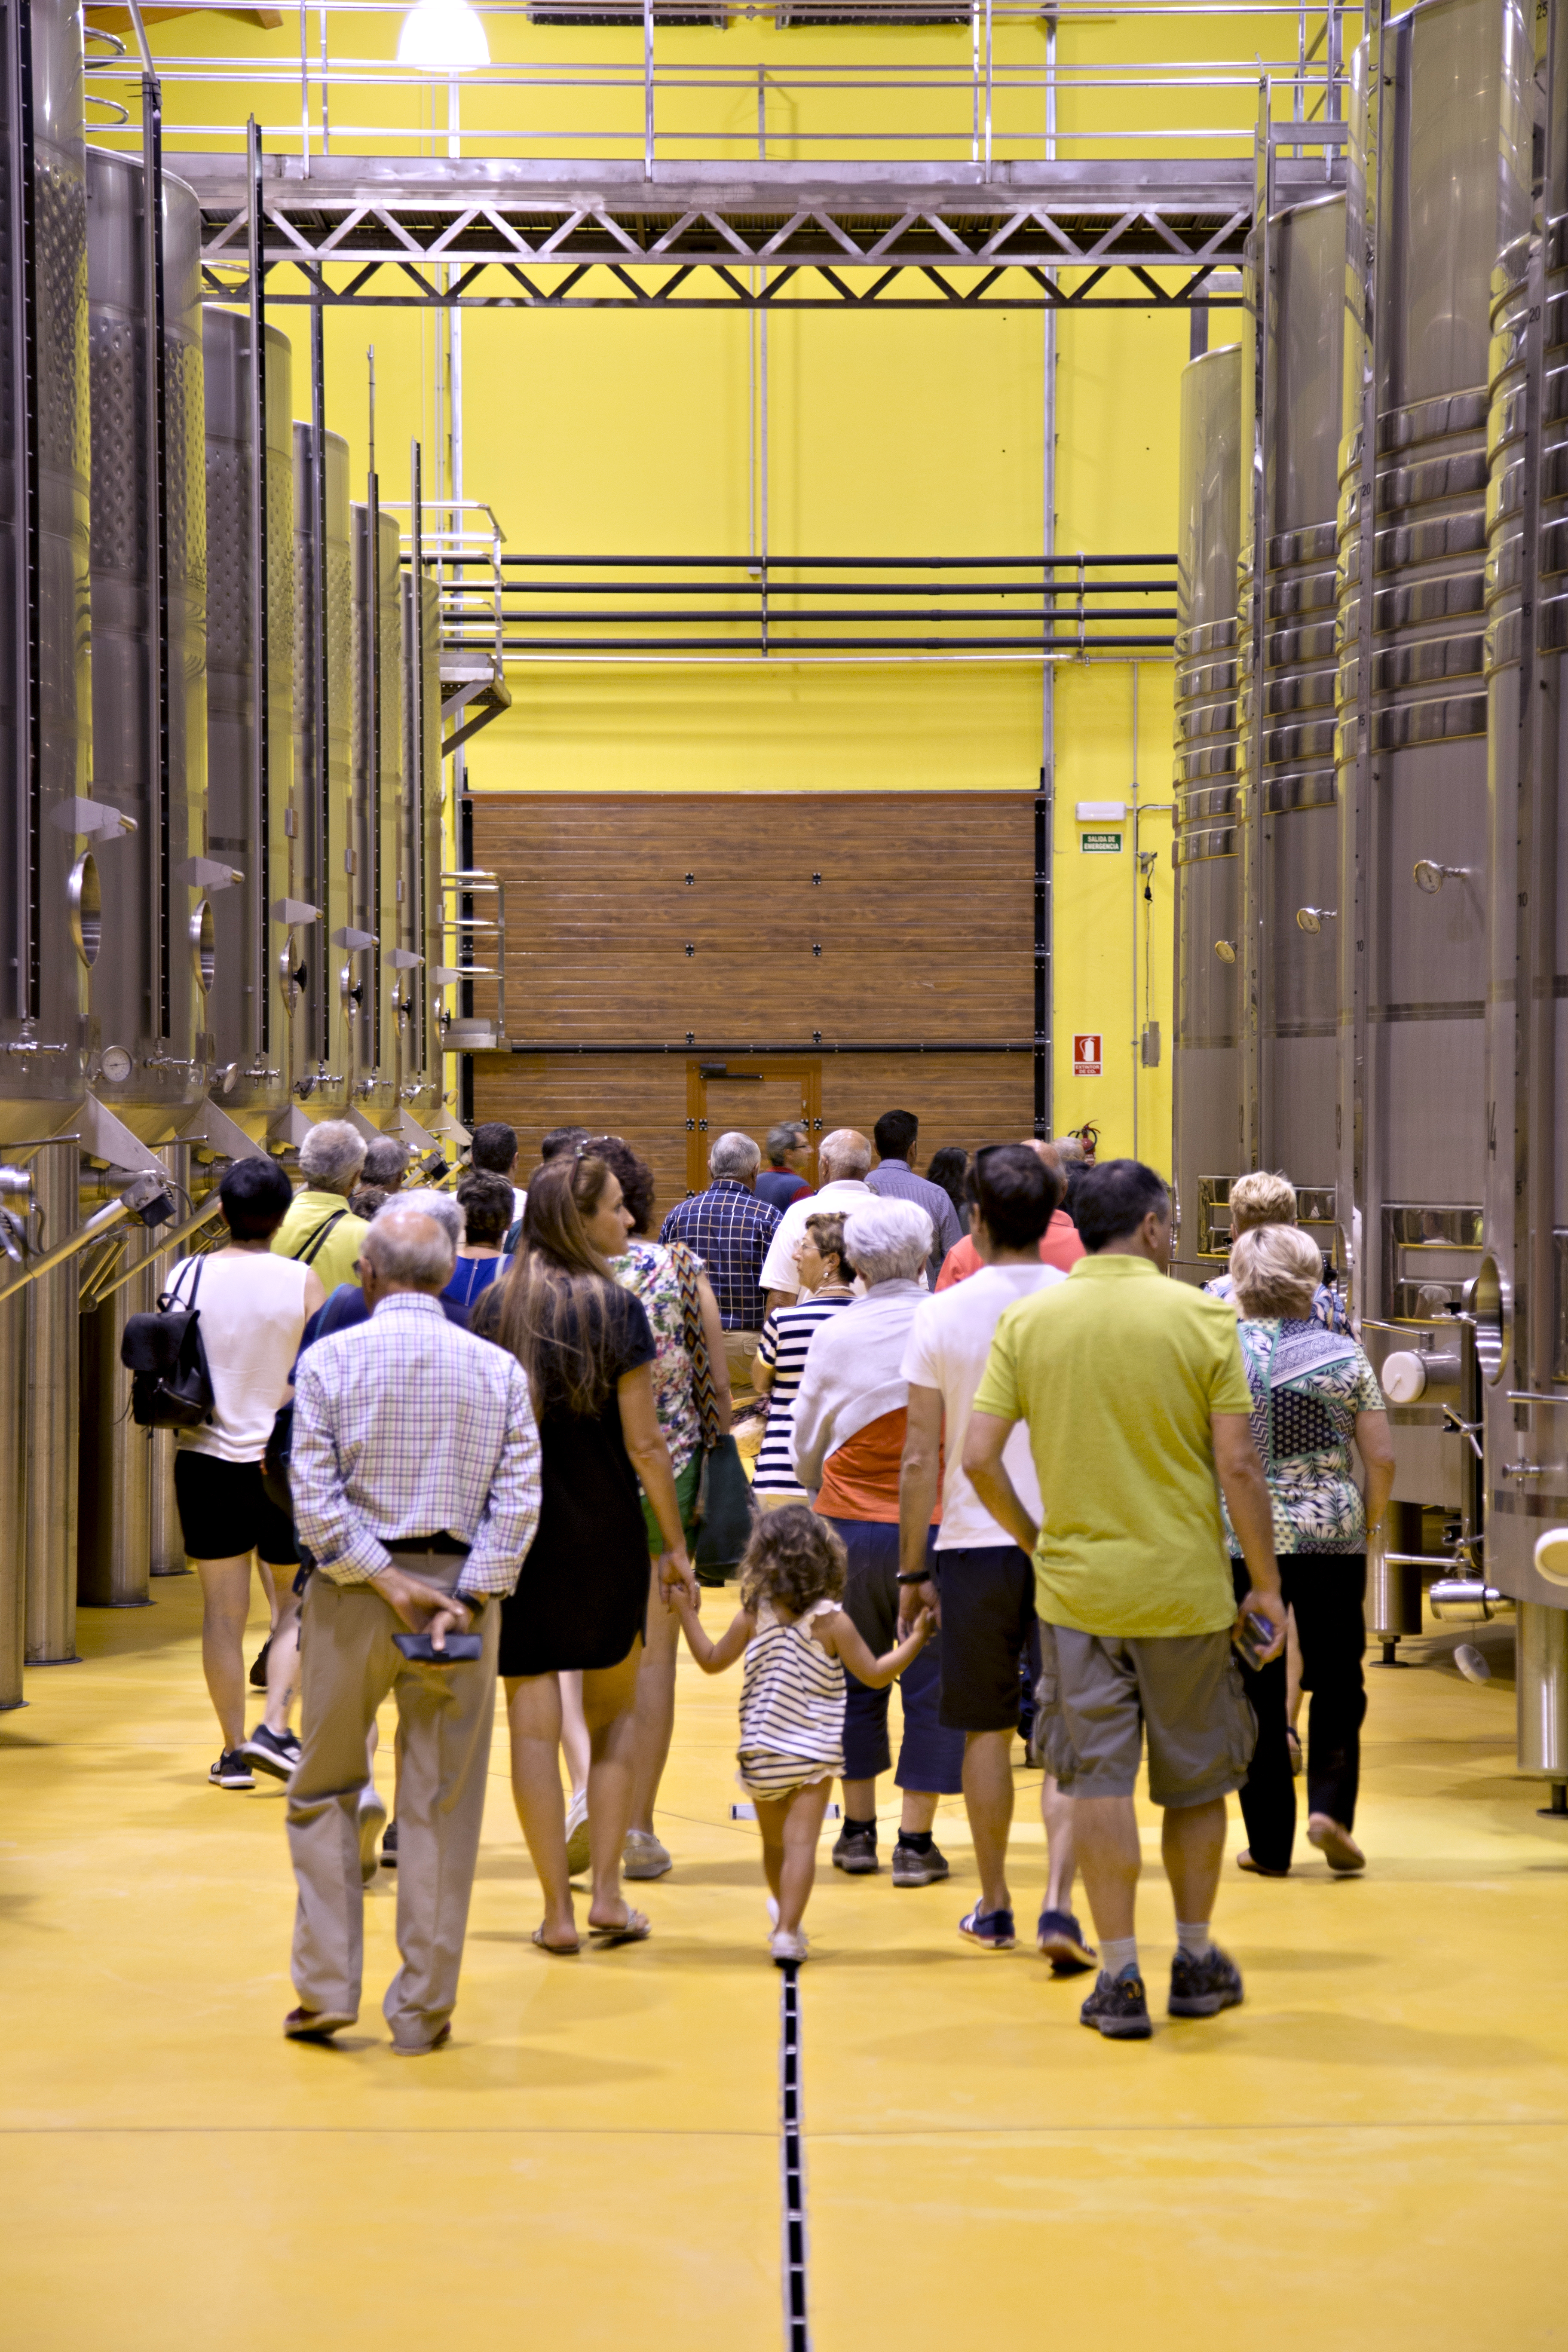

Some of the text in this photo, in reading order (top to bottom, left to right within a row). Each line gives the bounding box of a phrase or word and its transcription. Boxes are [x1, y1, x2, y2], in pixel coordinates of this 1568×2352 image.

[1536, 2, 1548, 21] 25
[1529, 306, 1540, 322] 20
[1362, 483, 1371, 496] 20
[1358, 714, 1365, 726] 15
[1518, 892, 1528, 907] 10
[1357, 940, 1364, 952] 10
